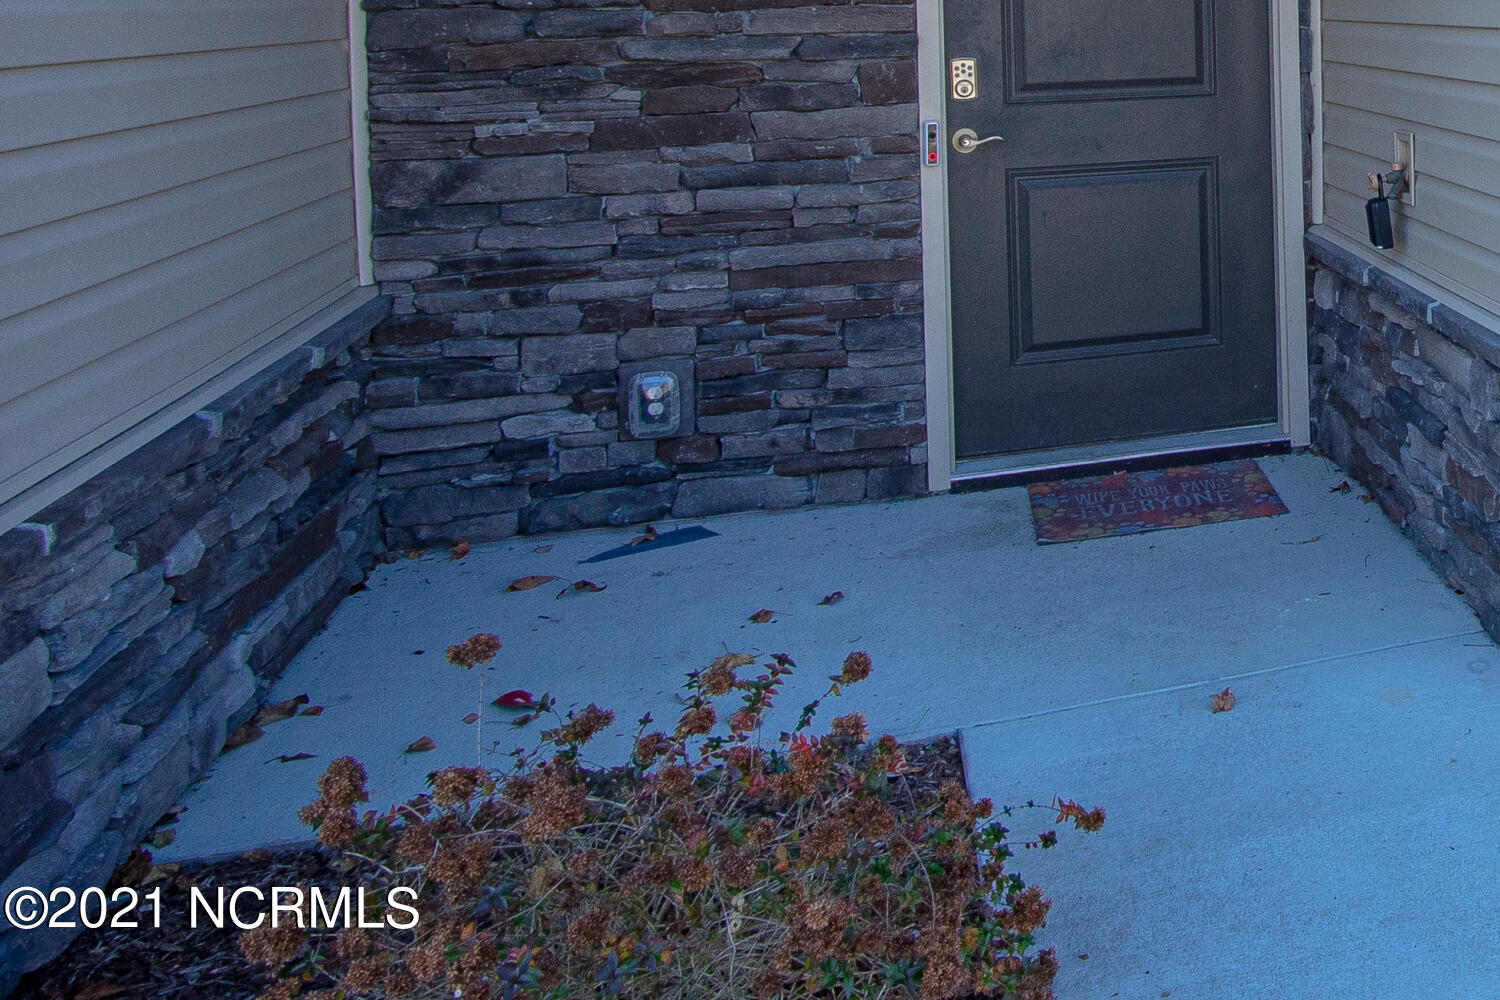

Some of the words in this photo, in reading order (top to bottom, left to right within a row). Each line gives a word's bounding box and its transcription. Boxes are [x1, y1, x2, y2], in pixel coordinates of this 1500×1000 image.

[1074, 489, 1121, 505] WIPE
[1129, 485, 1170, 499] YOUR
[1180, 478, 1228, 493] PAWS
[1079, 490, 1233, 520] EVERYONE
